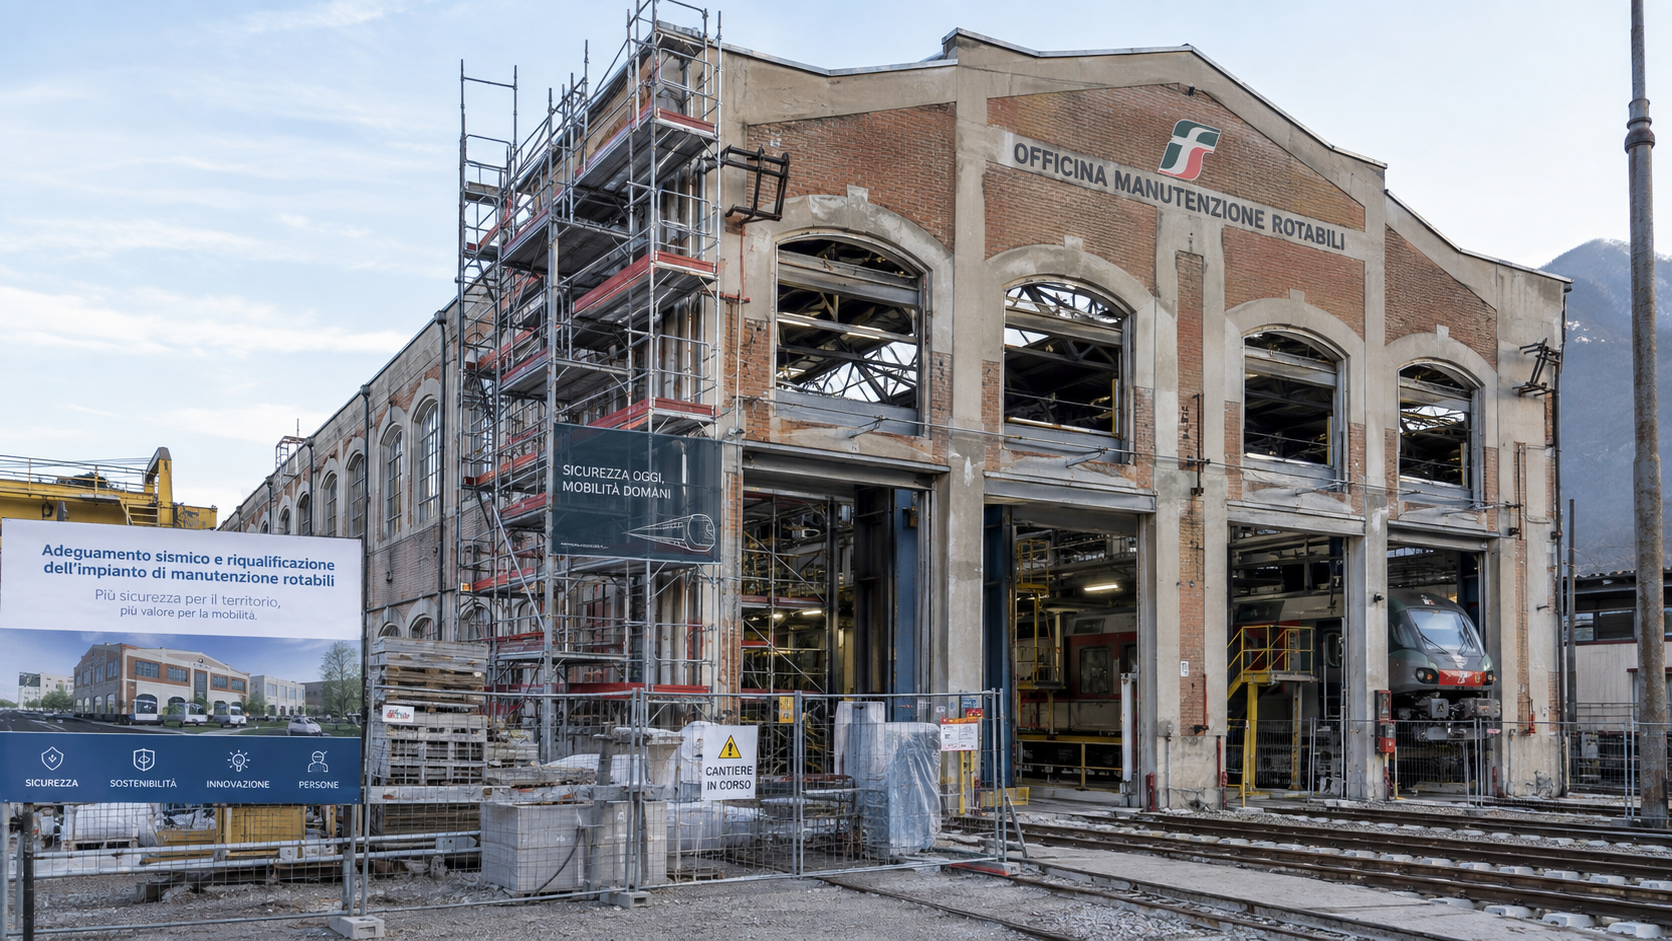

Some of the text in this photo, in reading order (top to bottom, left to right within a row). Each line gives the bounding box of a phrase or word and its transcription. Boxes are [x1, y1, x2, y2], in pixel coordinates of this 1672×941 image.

[1013, 142, 1345, 250] OFFICINA MANUTENZIONE ROTABILI
[562, 464, 665, 484] SICUREZZA OGGI,
[562, 481, 671, 499] MOBILITÀ DOMANI
[42, 544, 335, 570] Adeguamento sismico e riqualificazione
[152, 567, 166, 579] di
[171, 570, 278, 584] manutenzione
[283, 574, 335, 587] rotabili
[95, 588, 281, 609] Più sicurezza per il territorio,
[120, 606, 138, 617] più
[141, 606, 175, 617] valore
[178, 609, 196, 619] per
[199, 609, 208, 618] la
[705, 765, 753, 777] CANTIERE
[25, 778, 79, 788] SICUREZZA
[206, 780, 270, 789] INNOVAZIONE
[298, 781, 339, 790] PERSONE
[706, 780, 752, 791] IN CORSO
